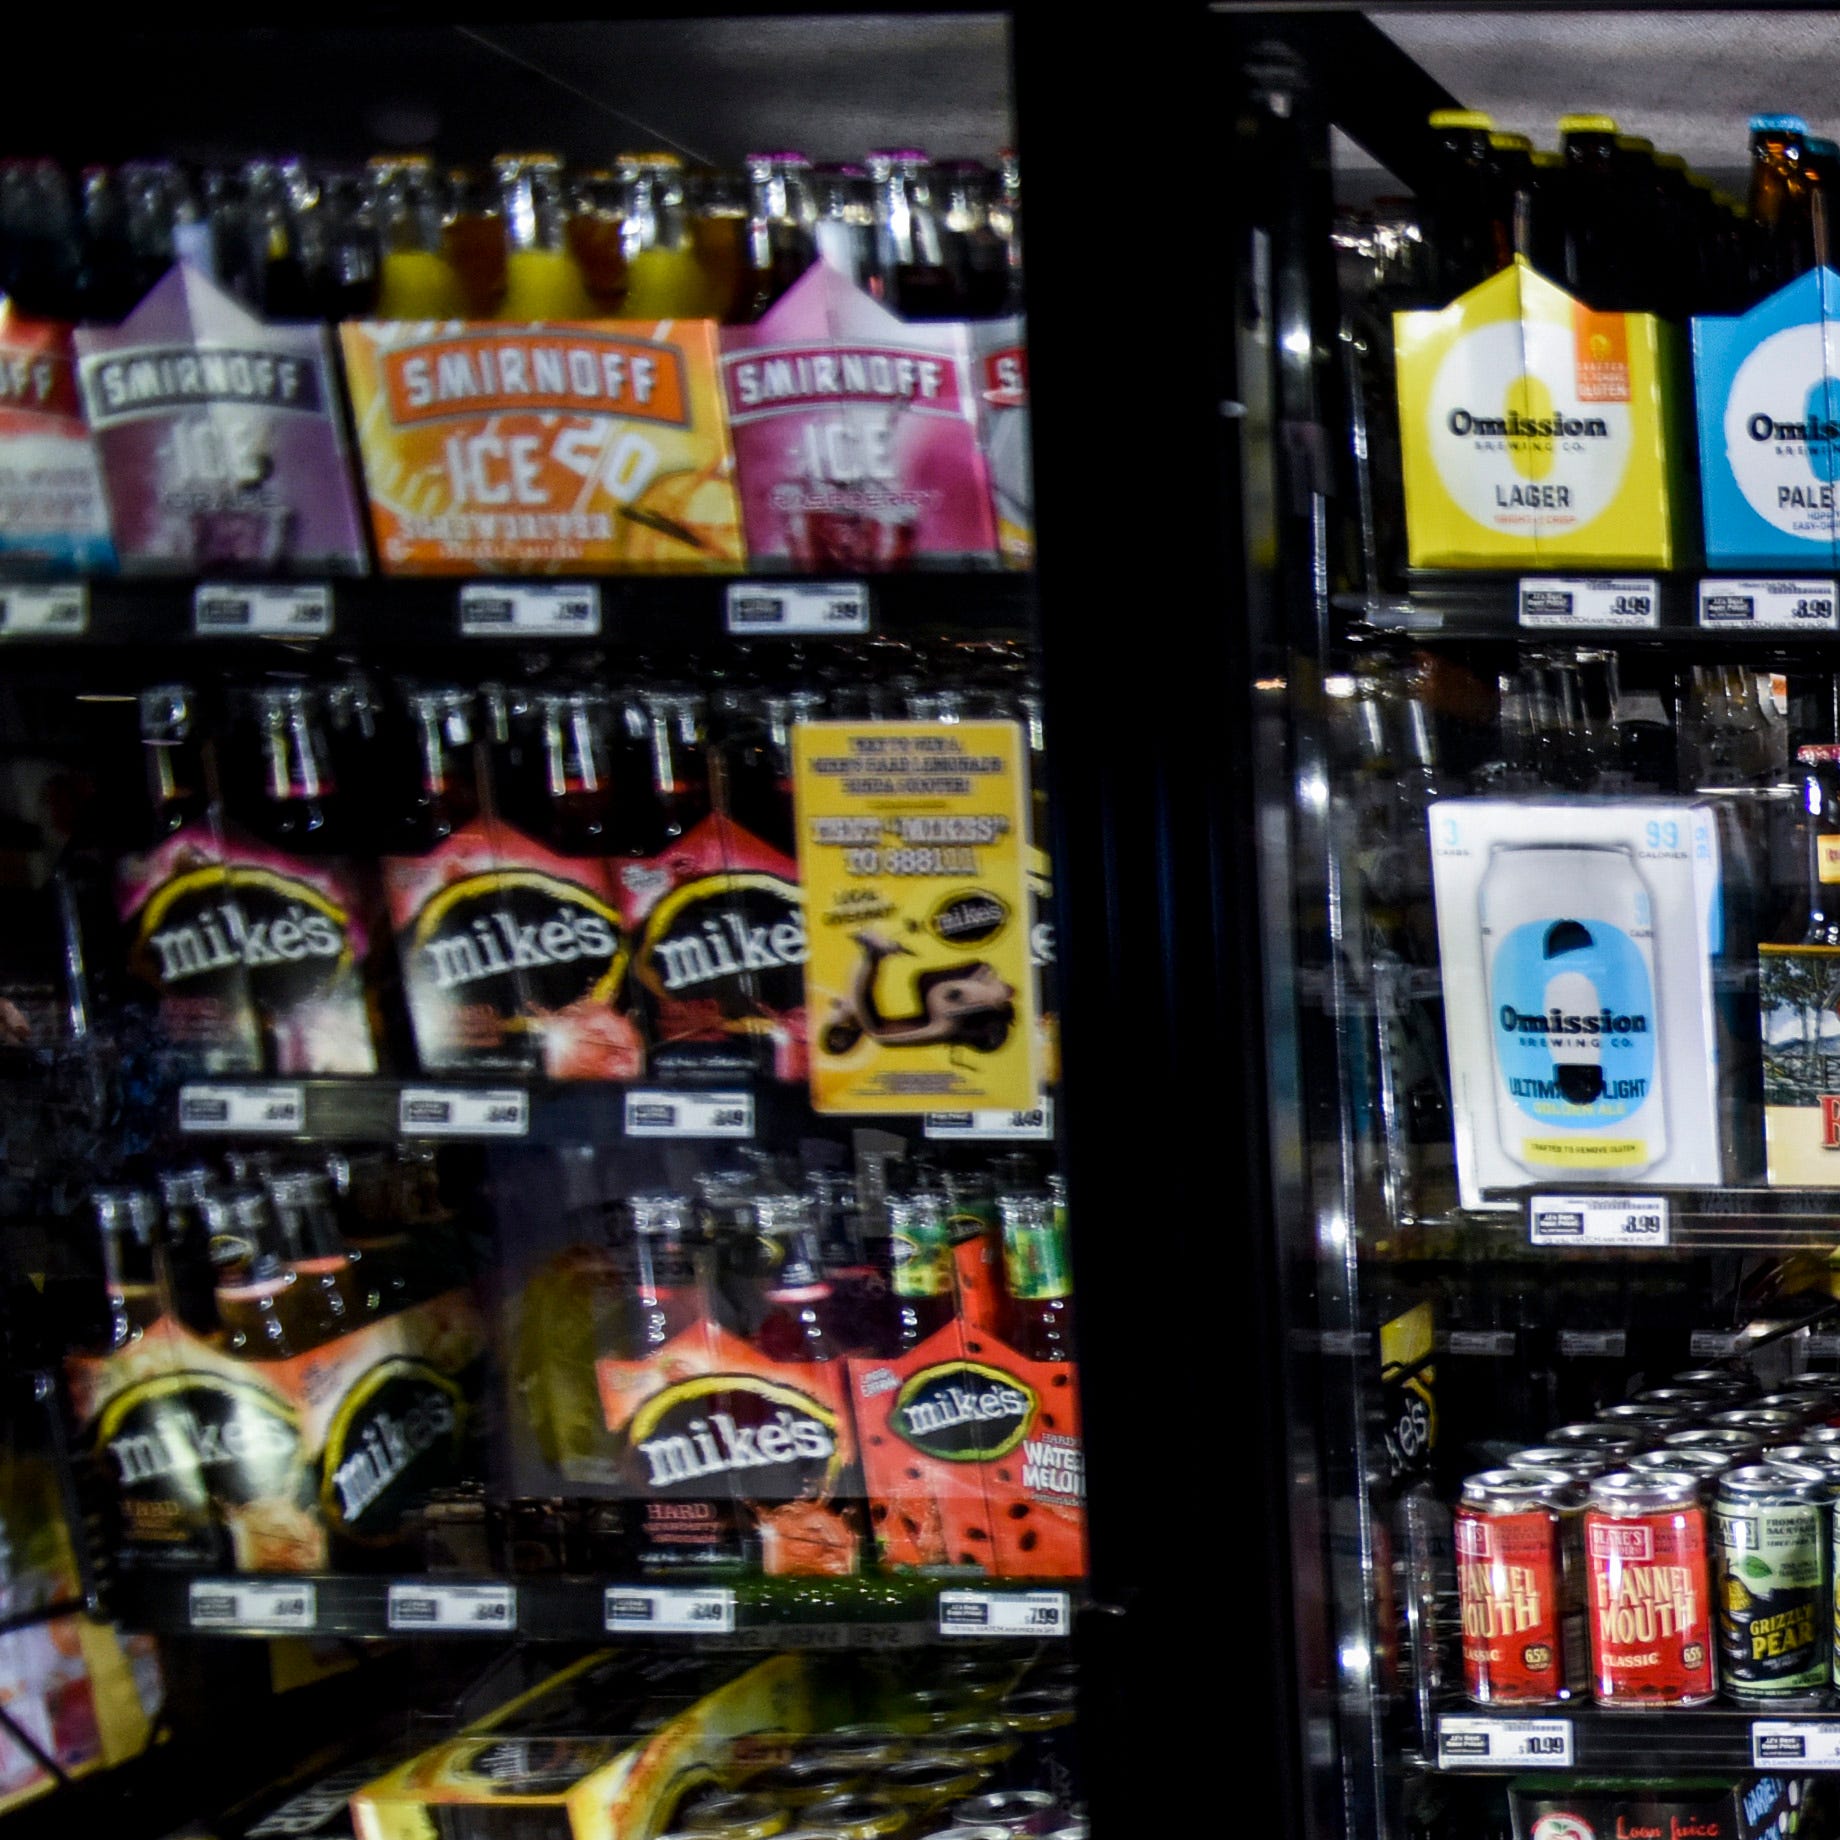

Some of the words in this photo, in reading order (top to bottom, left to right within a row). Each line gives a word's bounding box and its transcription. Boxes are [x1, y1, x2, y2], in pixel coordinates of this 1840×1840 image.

[97, 354, 302, 404] SMIRNOFF
[402, 346, 657, 407] SMIRNOFF
[735, 355, 945, 406] SMIRNOFF
[1449, 409, 1609, 438] Omission
[445, 432, 549, 505] ICE
[1495, 484, 1570, 508] LAGER
[1778, 485, 1833, 509] PALE
[150, 903, 343, 982] mike's
[424, 911, 617, 989] mike's
[905, 1376, 1035, 1436] mike's
[644, 1409, 833, 1489] mike's
[1749, 1602, 1815, 1638] GRIZZLY
[1750, 1623, 1815, 1660] PEAR
